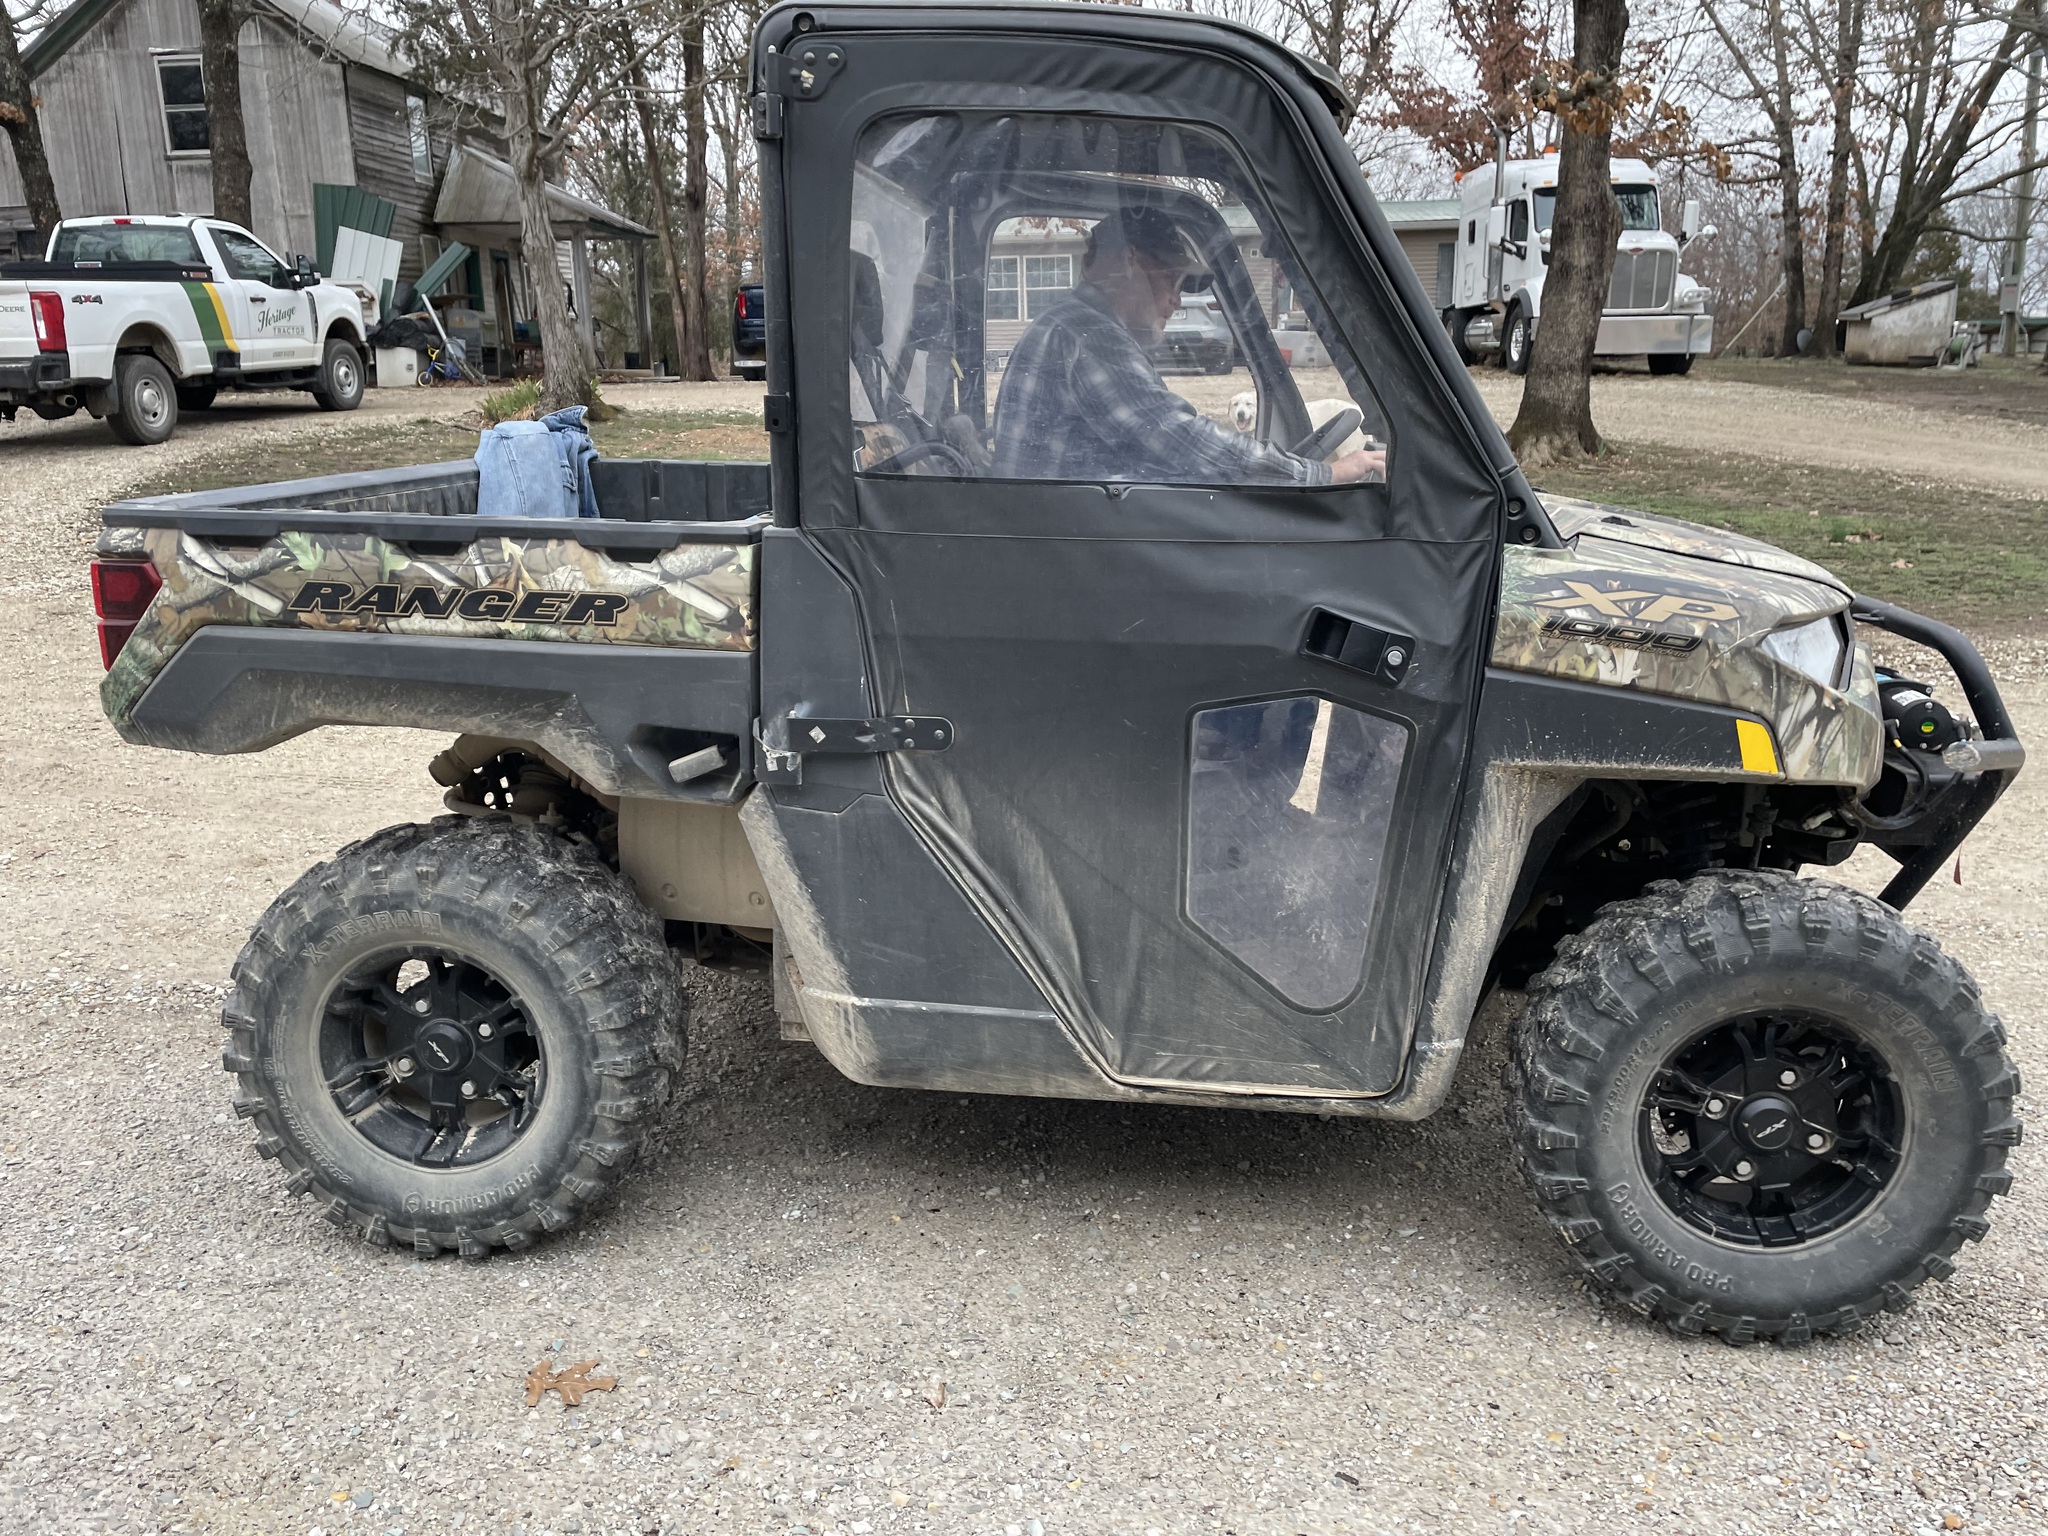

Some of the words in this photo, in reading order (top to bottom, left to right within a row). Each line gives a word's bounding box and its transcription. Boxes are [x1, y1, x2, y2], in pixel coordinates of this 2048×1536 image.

[257, 306, 296, 333] Heritage
[273, 326, 305, 336] TRACTOR
[286, 579, 629, 627] RANGER
[1533, 579, 1743, 623] XP
[1540, 614, 1703, 652] 1000
[301, 909, 443, 967] X-TERRAIN
[427, 1040, 450, 1064] XP
[1827, 978, 1961, 1092] X-TERRAIN
[1756, 1118, 1787, 1138] XP
[503, 1162, 543, 1197] PRO
[426, 1186, 502, 1216] ARMOR
[1620, 1201, 1688, 1271] ARMOR
[1685, 1261, 1735, 1294] PRO
